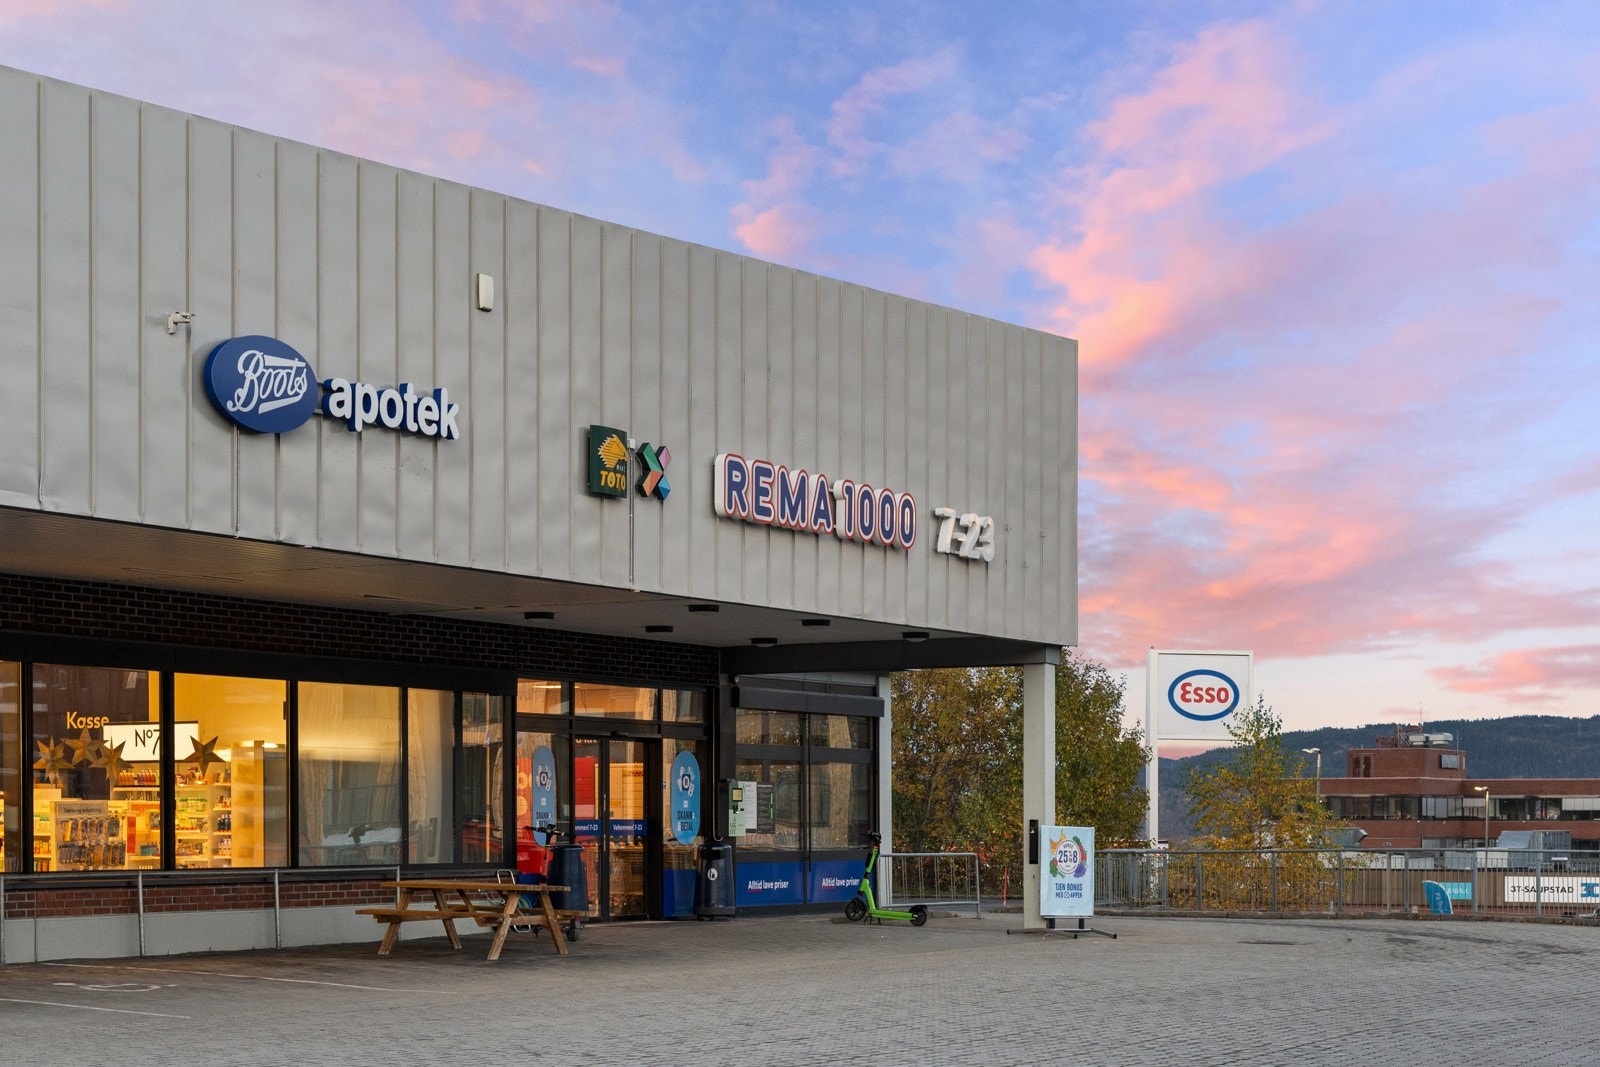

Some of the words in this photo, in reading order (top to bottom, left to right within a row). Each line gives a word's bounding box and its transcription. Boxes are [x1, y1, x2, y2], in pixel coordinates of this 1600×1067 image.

[227, 349, 308, 414] Boots
[325, 377, 460, 440] apotek
[600, 470, 627, 491] TOTO
[718, 452, 836, 535] REMA
[836, 478, 918, 551] 1000
[935, 507, 995, 562] 7-23
[66, 711, 110, 730] Kasse
[748, 880, 762, 890] Alltid
[763, 880, 774, 889] lave
[774, 879, 789, 890] priser
[821, 878, 836, 887] Alltid
[836, 878, 846, 887] lave
[846, 877, 860, 887] priser
